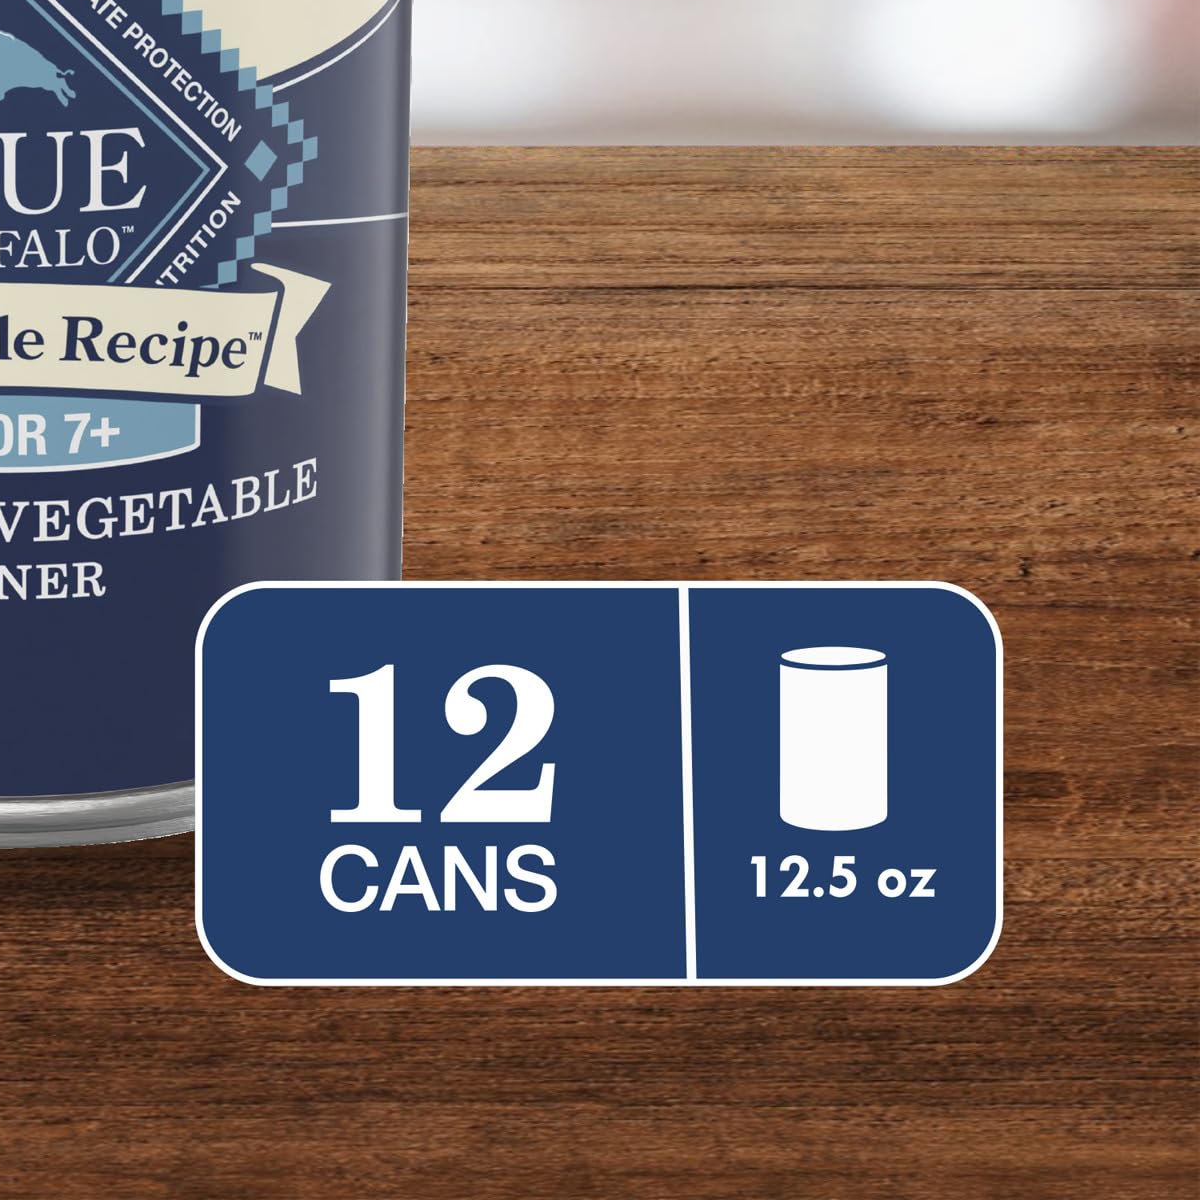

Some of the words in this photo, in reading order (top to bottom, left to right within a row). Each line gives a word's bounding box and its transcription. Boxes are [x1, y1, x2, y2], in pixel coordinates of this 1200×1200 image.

[121, 21, 243, 143] PROTECTION
[154, 190, 242, 286] TRITION
[63, 412, 121, 455] 7+
